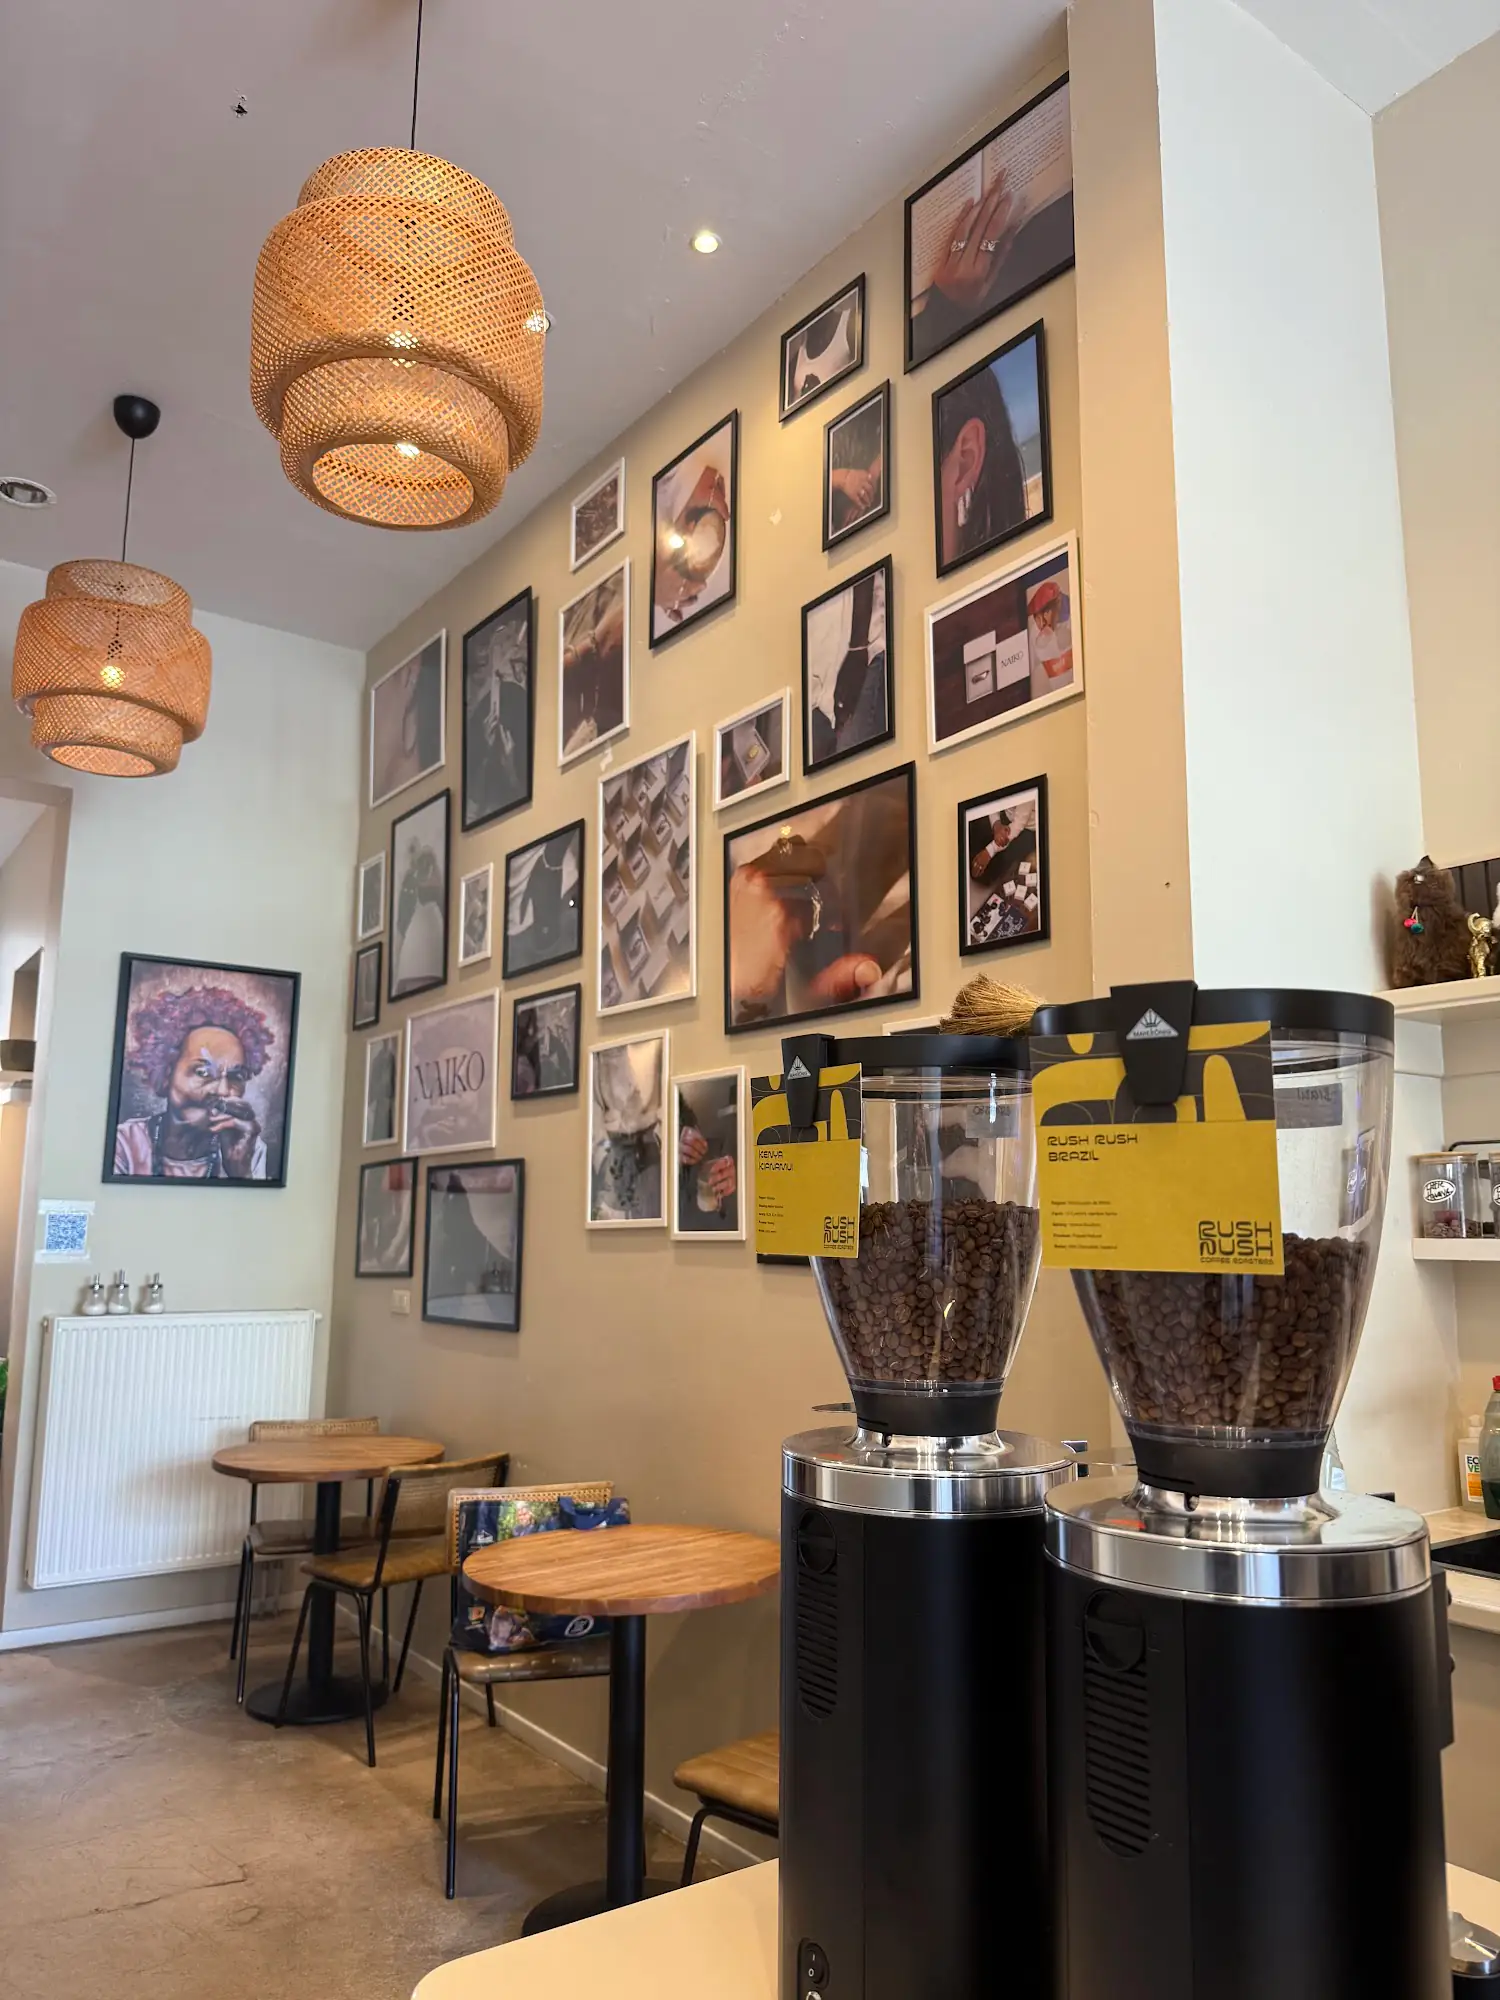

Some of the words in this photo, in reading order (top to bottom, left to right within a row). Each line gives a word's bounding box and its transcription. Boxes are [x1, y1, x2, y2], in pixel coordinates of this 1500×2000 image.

[1001, 651, 1024, 669] NAIKO
[1047, 1134, 1090, 1146] RUSH
[1094, 1133, 1139, 1145] RUSH
[758, 1149, 784, 1160] KENYA
[1048, 1149, 1100, 1162] BRAZIL
[824, 1216, 856, 1230] RUSH
[1199, 1220, 1273, 1238] RUSH
[1467, 1456, 1480, 1465] EC
